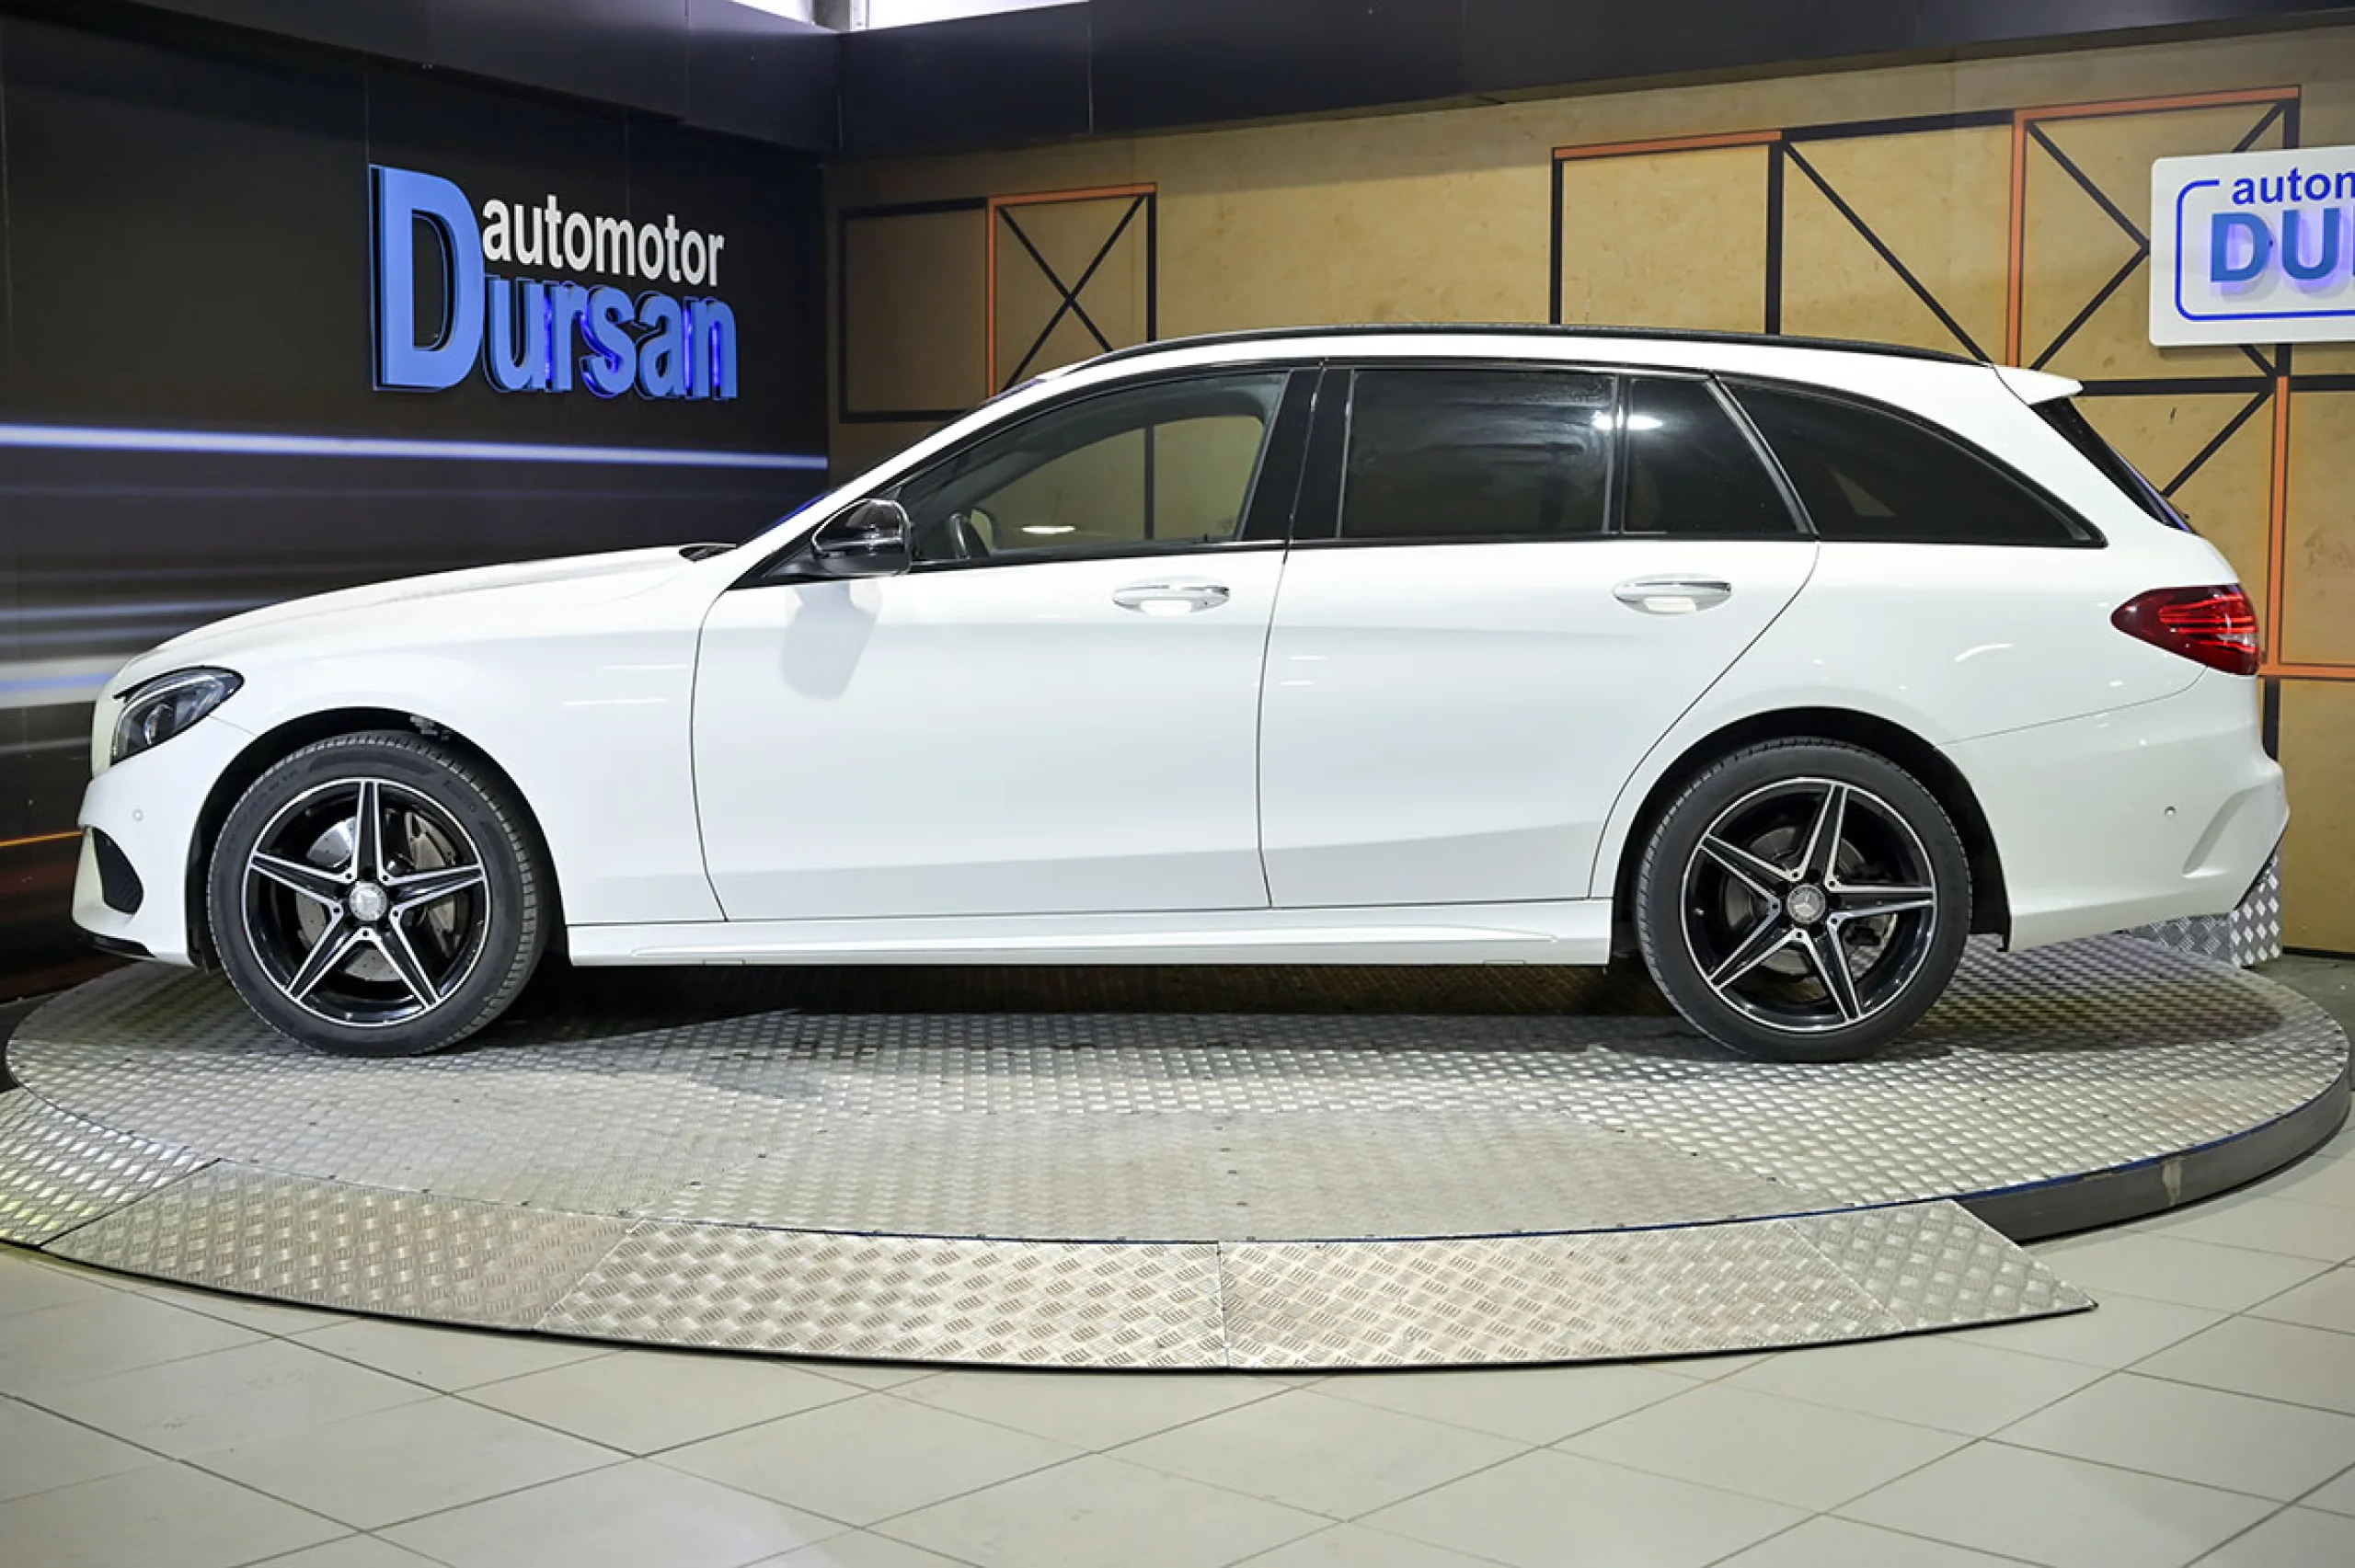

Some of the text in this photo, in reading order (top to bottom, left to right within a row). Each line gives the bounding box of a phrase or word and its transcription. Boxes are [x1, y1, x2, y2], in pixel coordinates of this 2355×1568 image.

[369, 164, 738, 400] Dursan
[482, 194, 724, 286] automotor
[2210, 207, 2355, 283] DU
